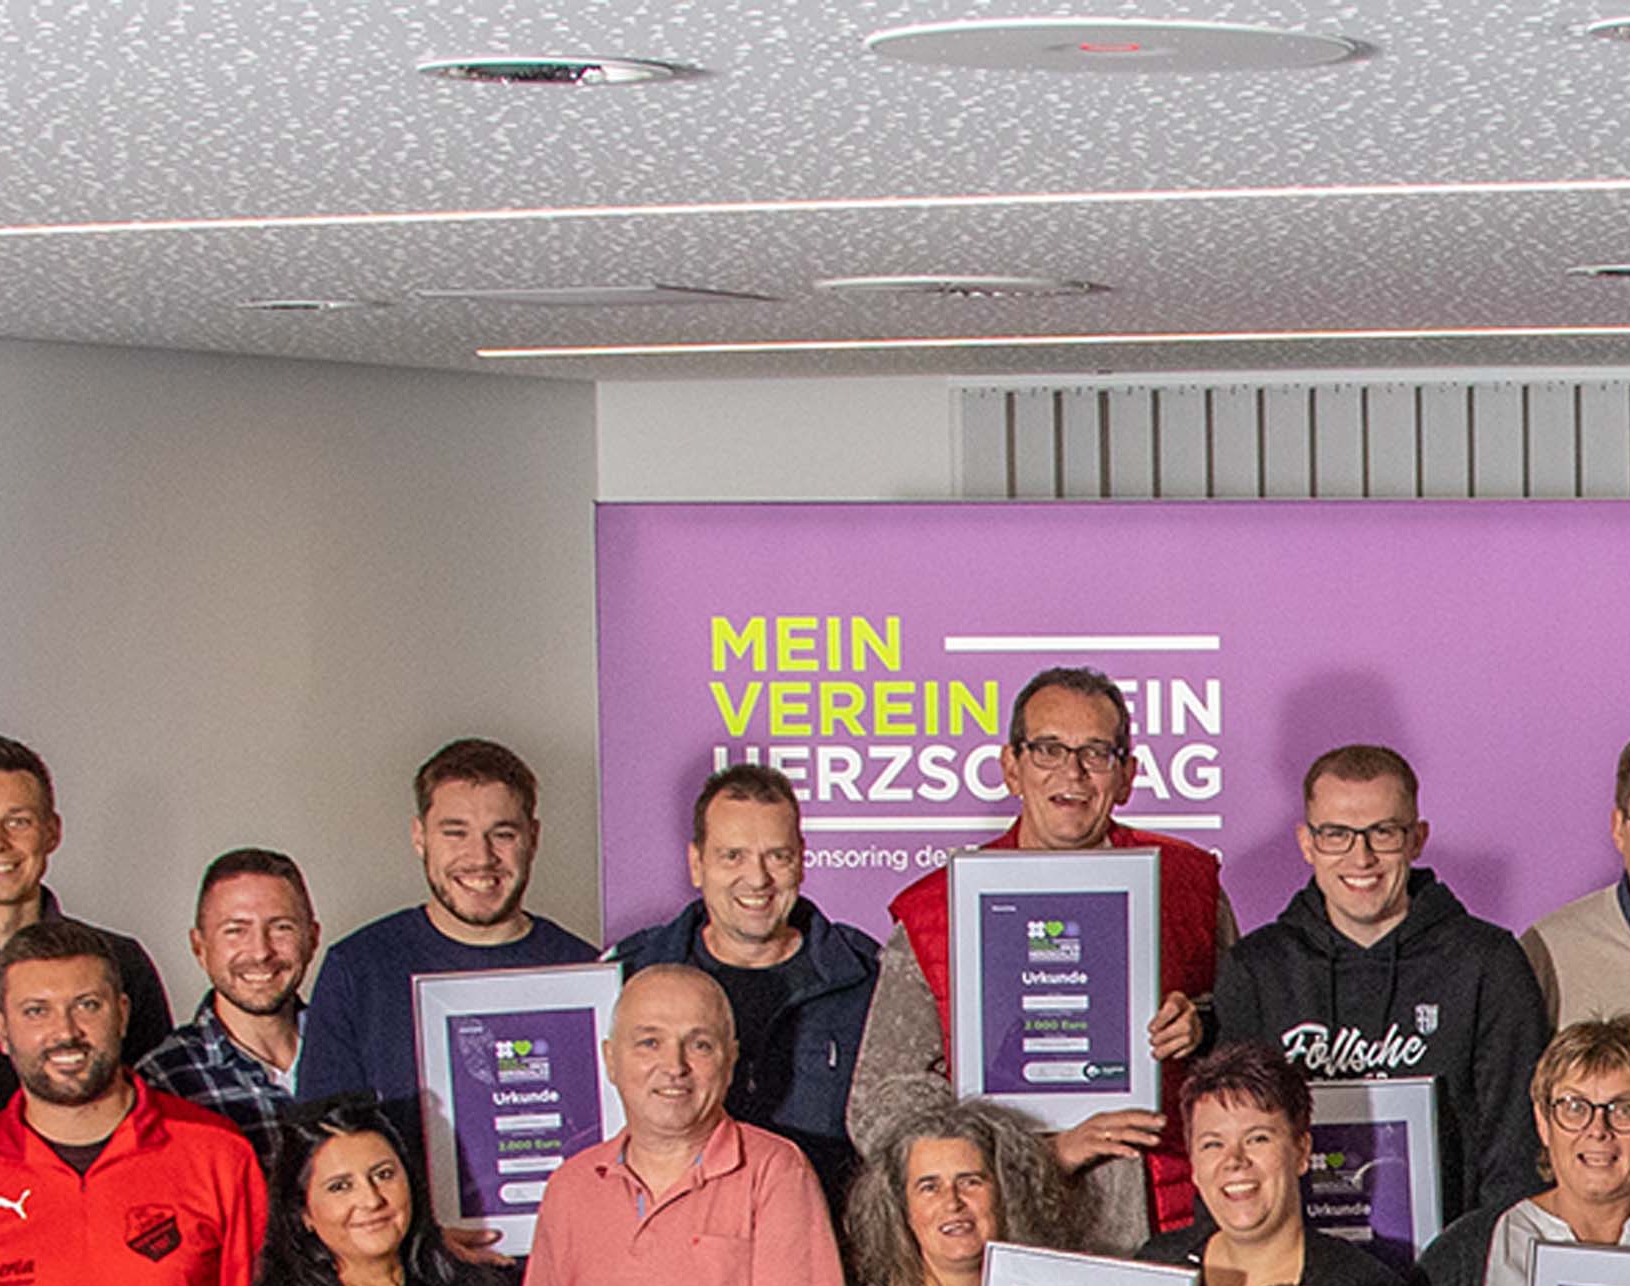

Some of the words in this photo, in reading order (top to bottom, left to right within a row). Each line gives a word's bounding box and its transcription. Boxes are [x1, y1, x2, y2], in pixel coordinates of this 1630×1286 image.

[711, 616, 901, 671] MEIN
[711, 681, 998, 736] VEREIN
[1118, 679, 1221, 735] EIN
[1022, 971, 1088, 985] Urkunde
[493, 1090, 560, 1105] Urkunde
[1307, 1203, 1370, 1216] Urkunde
